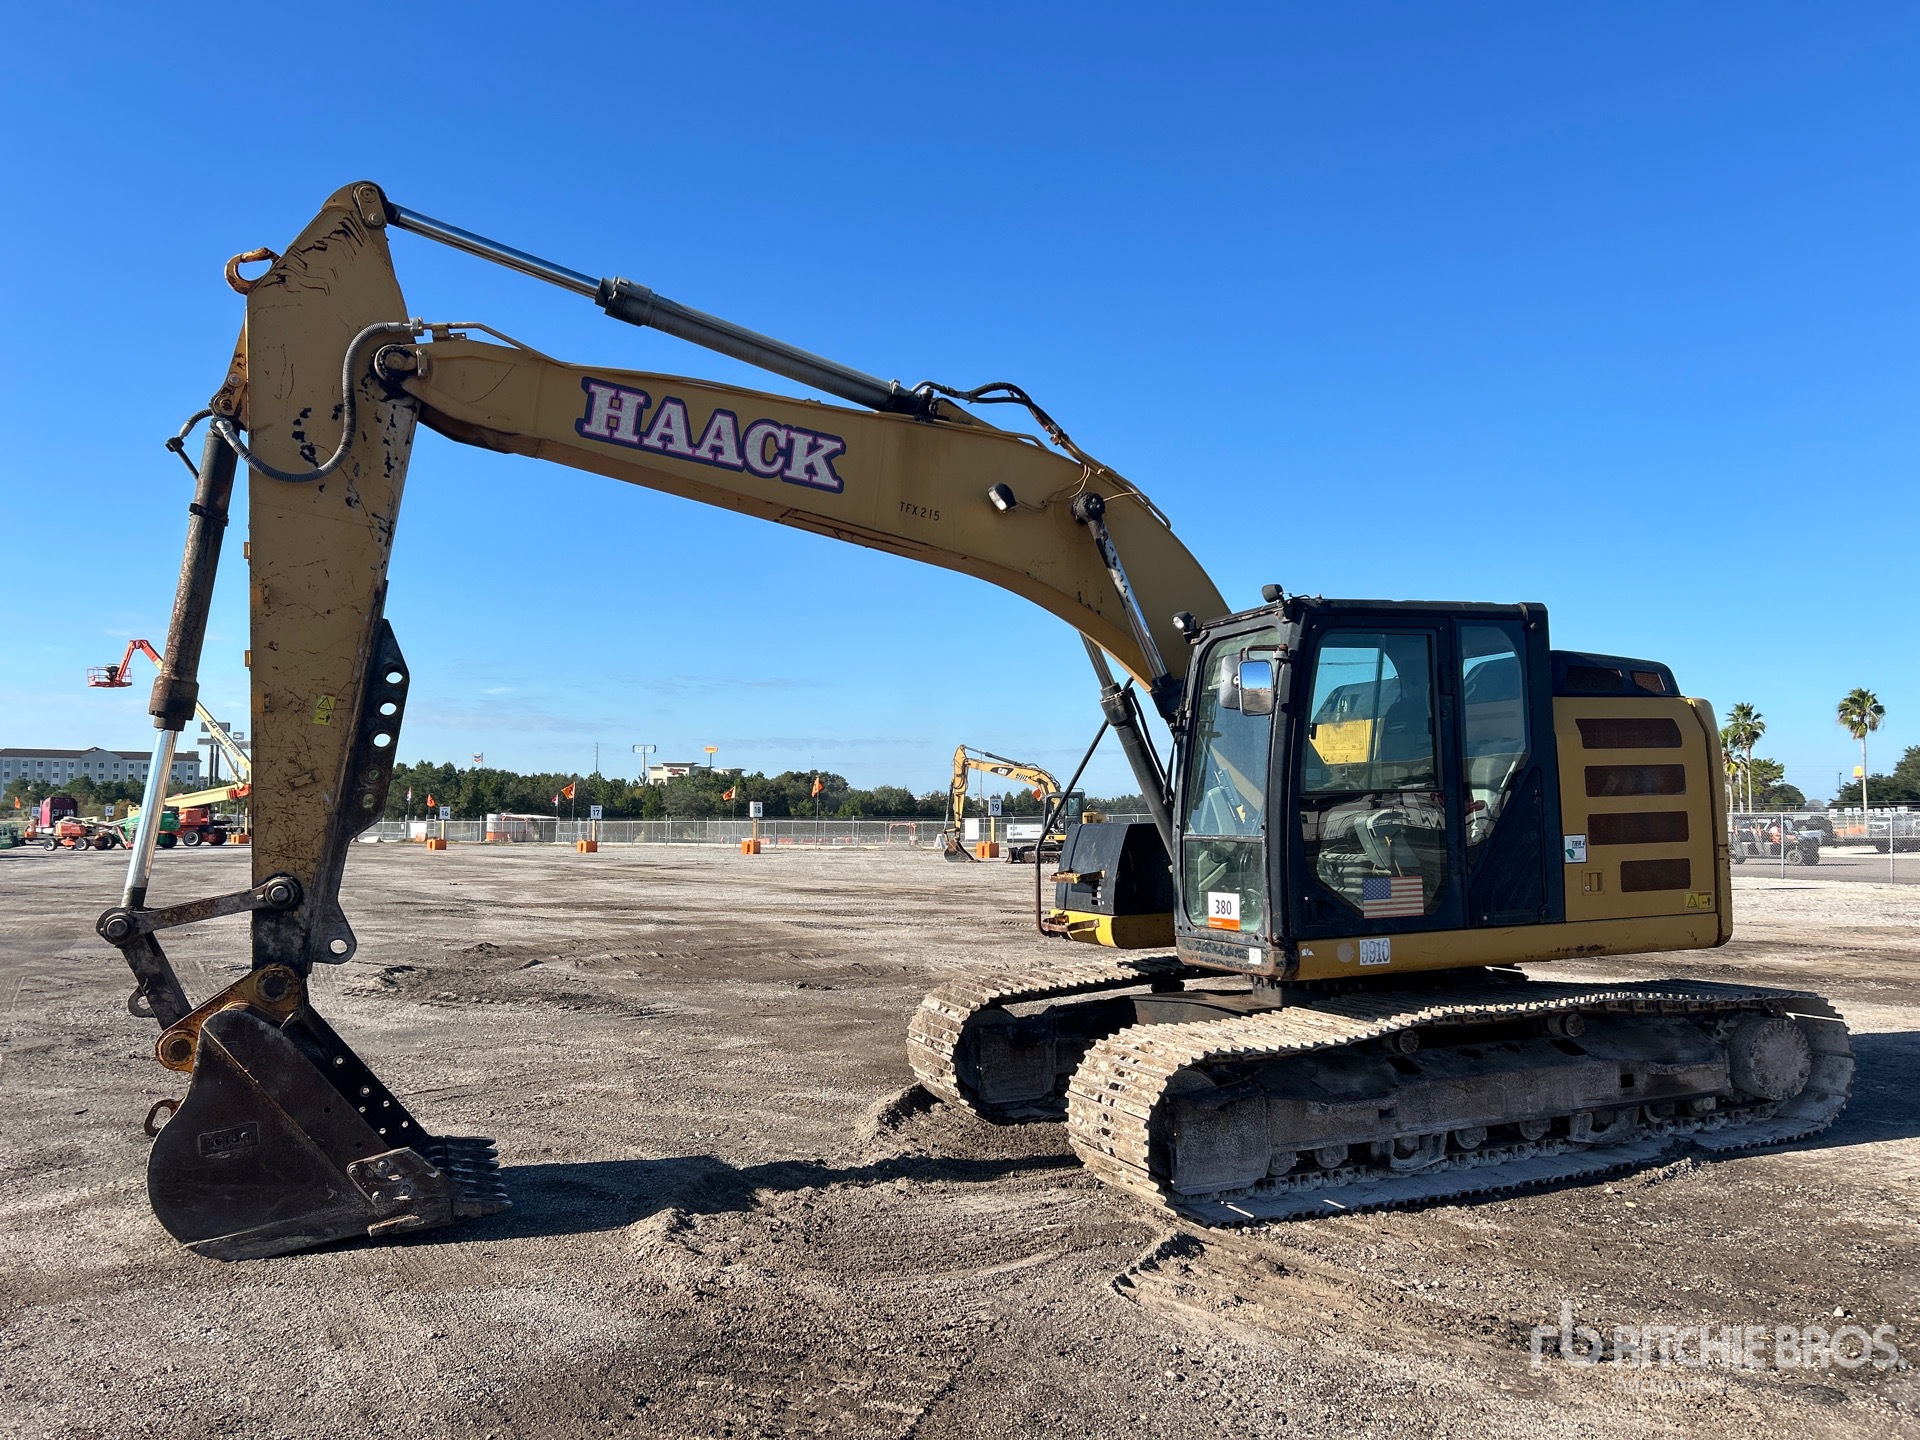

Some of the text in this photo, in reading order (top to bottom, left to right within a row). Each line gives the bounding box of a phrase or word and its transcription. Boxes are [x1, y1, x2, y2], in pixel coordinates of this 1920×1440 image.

[577, 378, 845, 493] HAACK
[207, 720, 217, 729] JLG
[997, 767, 1008, 775] CAT
[991, 803, 1000, 812] 19
[1215, 899, 1232, 915] 380
[1361, 940, 1389, 963] 9910
